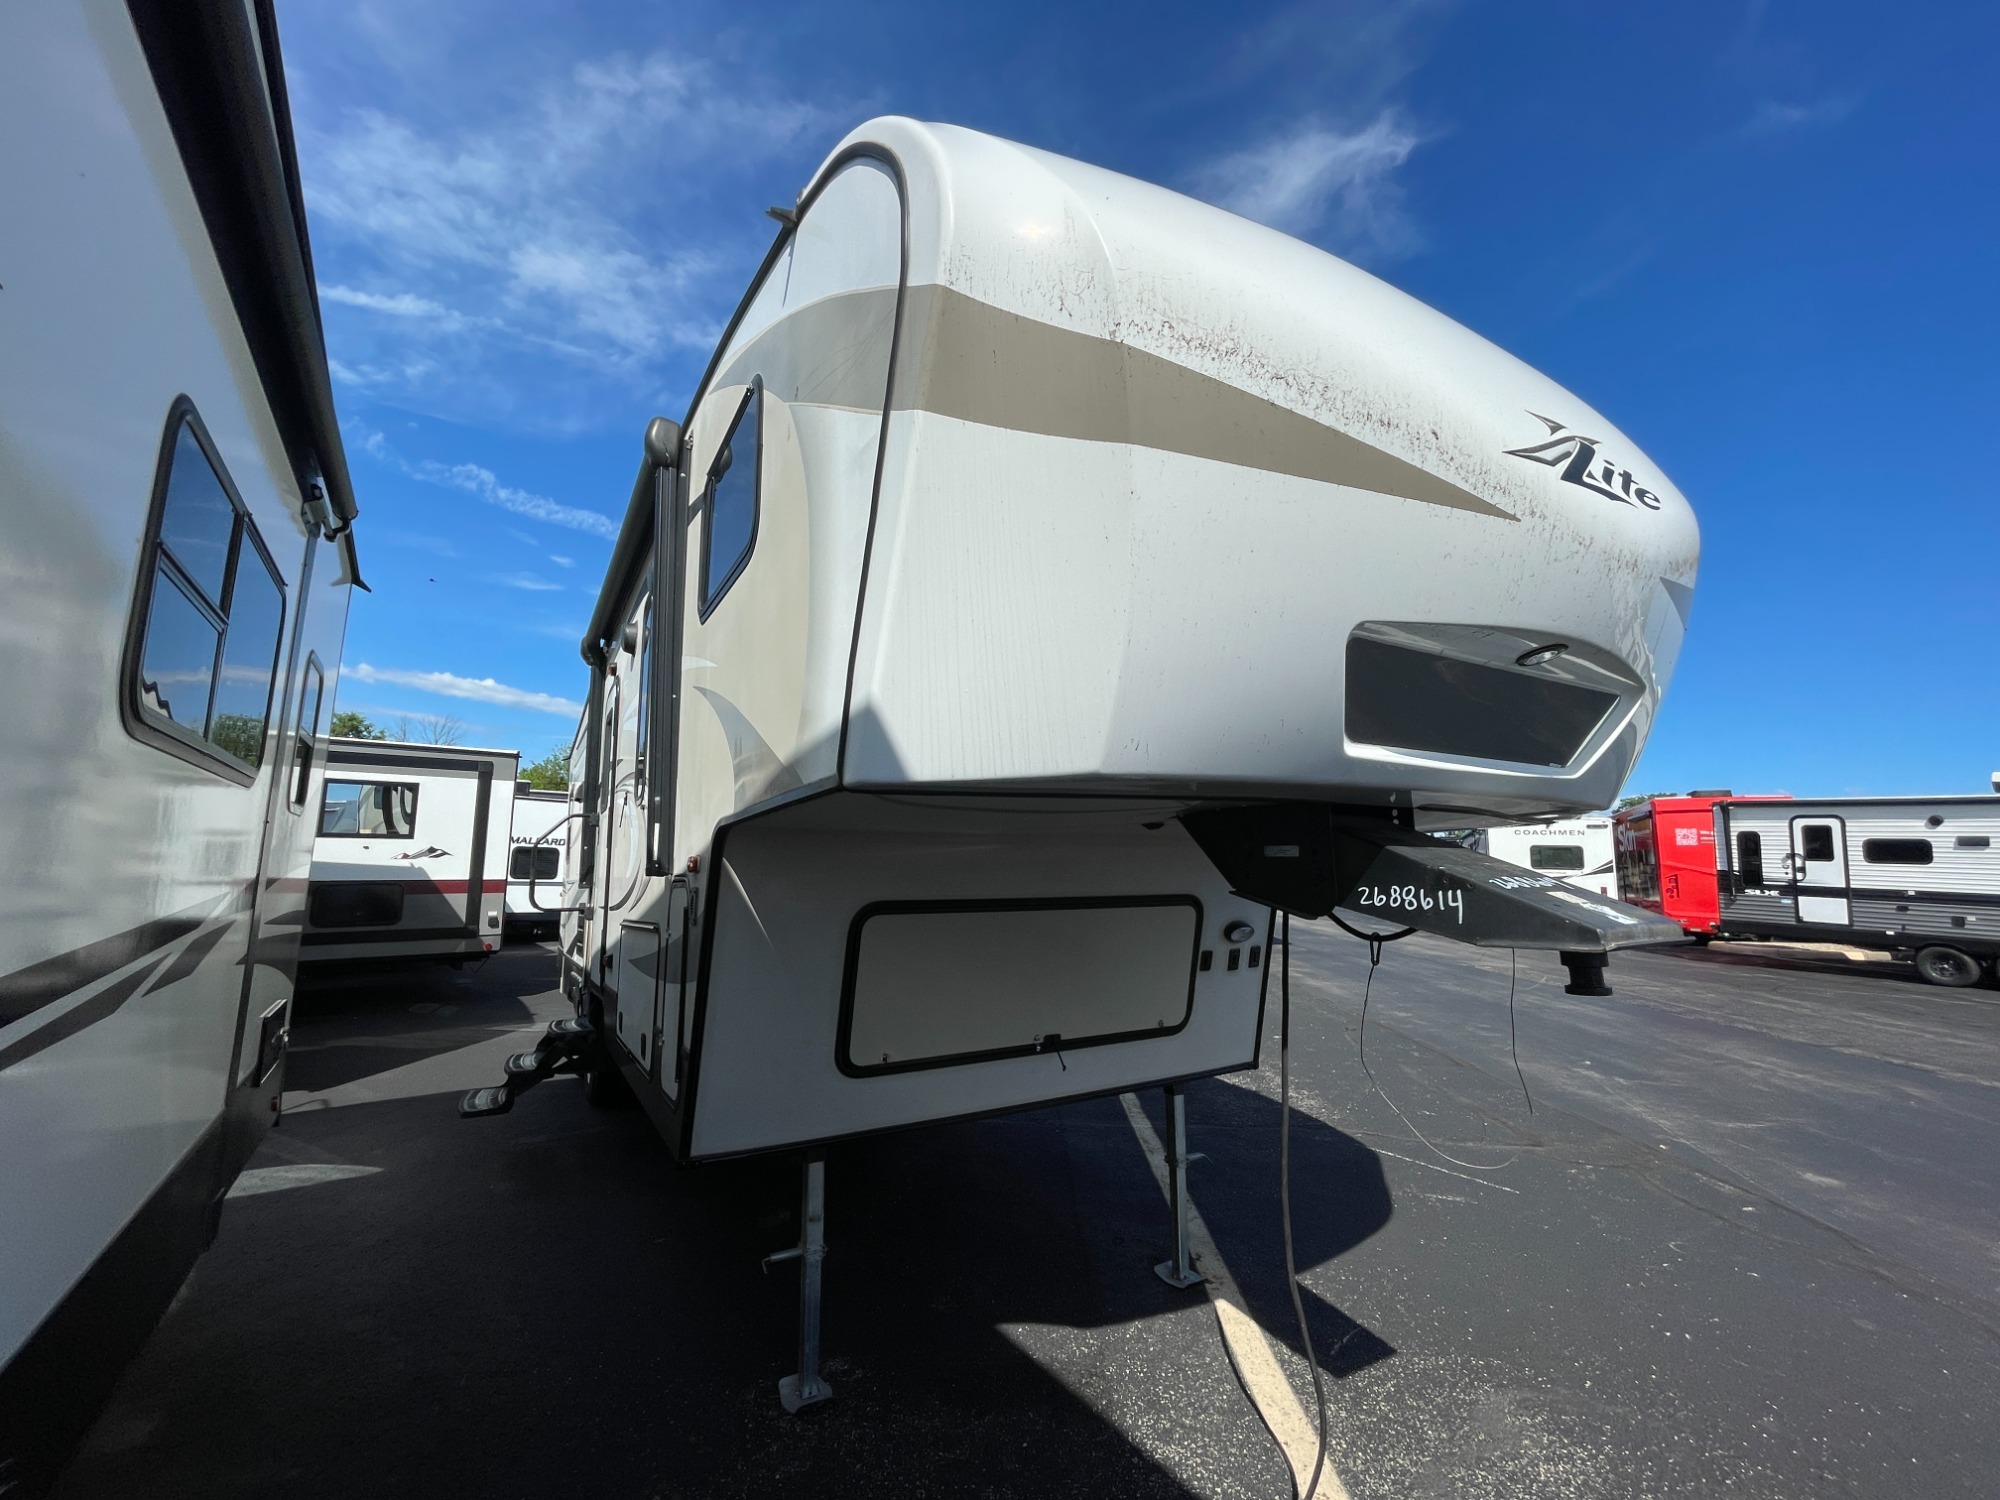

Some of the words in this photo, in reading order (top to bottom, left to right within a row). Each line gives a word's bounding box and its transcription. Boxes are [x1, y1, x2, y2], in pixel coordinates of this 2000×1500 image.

[1560, 439, 1661, 511] Lite
[511, 836, 566, 846] MALLARD
[1514, 828, 1585, 836] COACHMEN
[1357, 885, 1463, 925] 2688614
